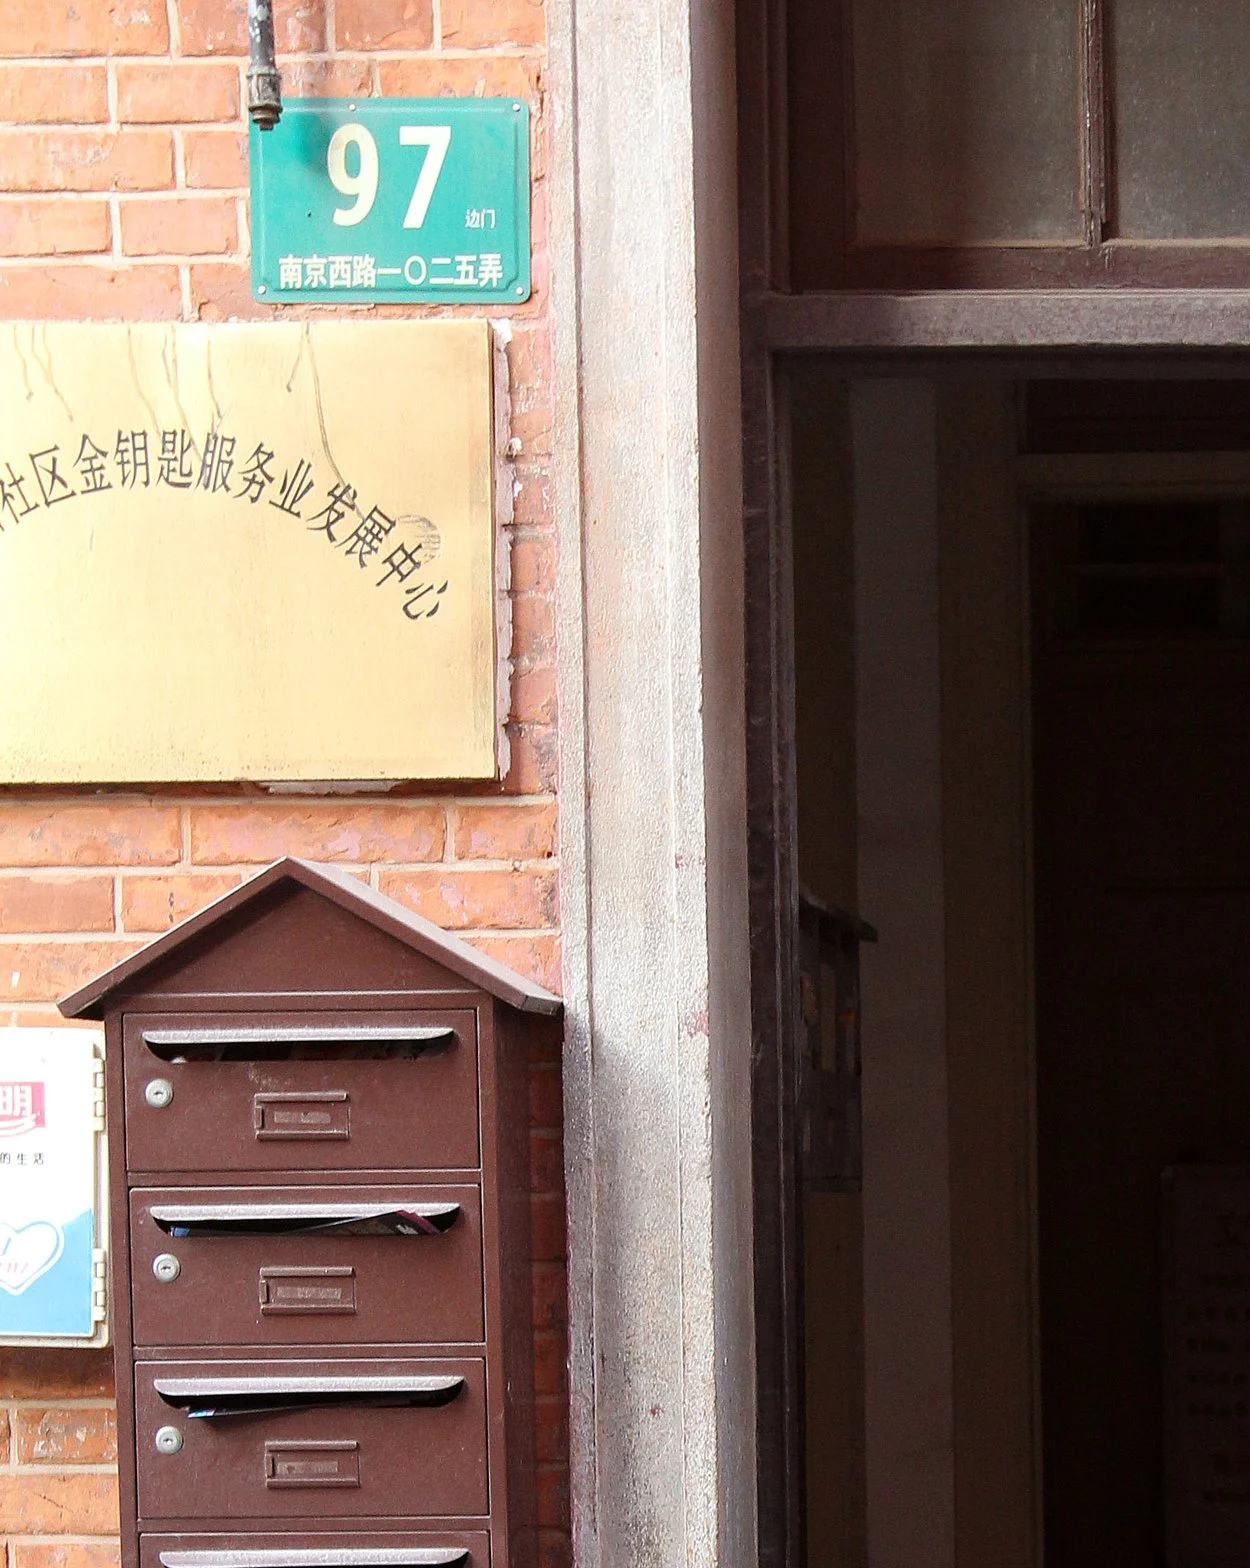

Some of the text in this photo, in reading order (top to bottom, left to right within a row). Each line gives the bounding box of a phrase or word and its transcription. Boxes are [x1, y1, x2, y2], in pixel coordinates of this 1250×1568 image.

[327, 123, 451, 229] 97
[464, 209, 496, 229] 边门
[0, 428, 448, 620] 社区金钥匙服务业发展中心
